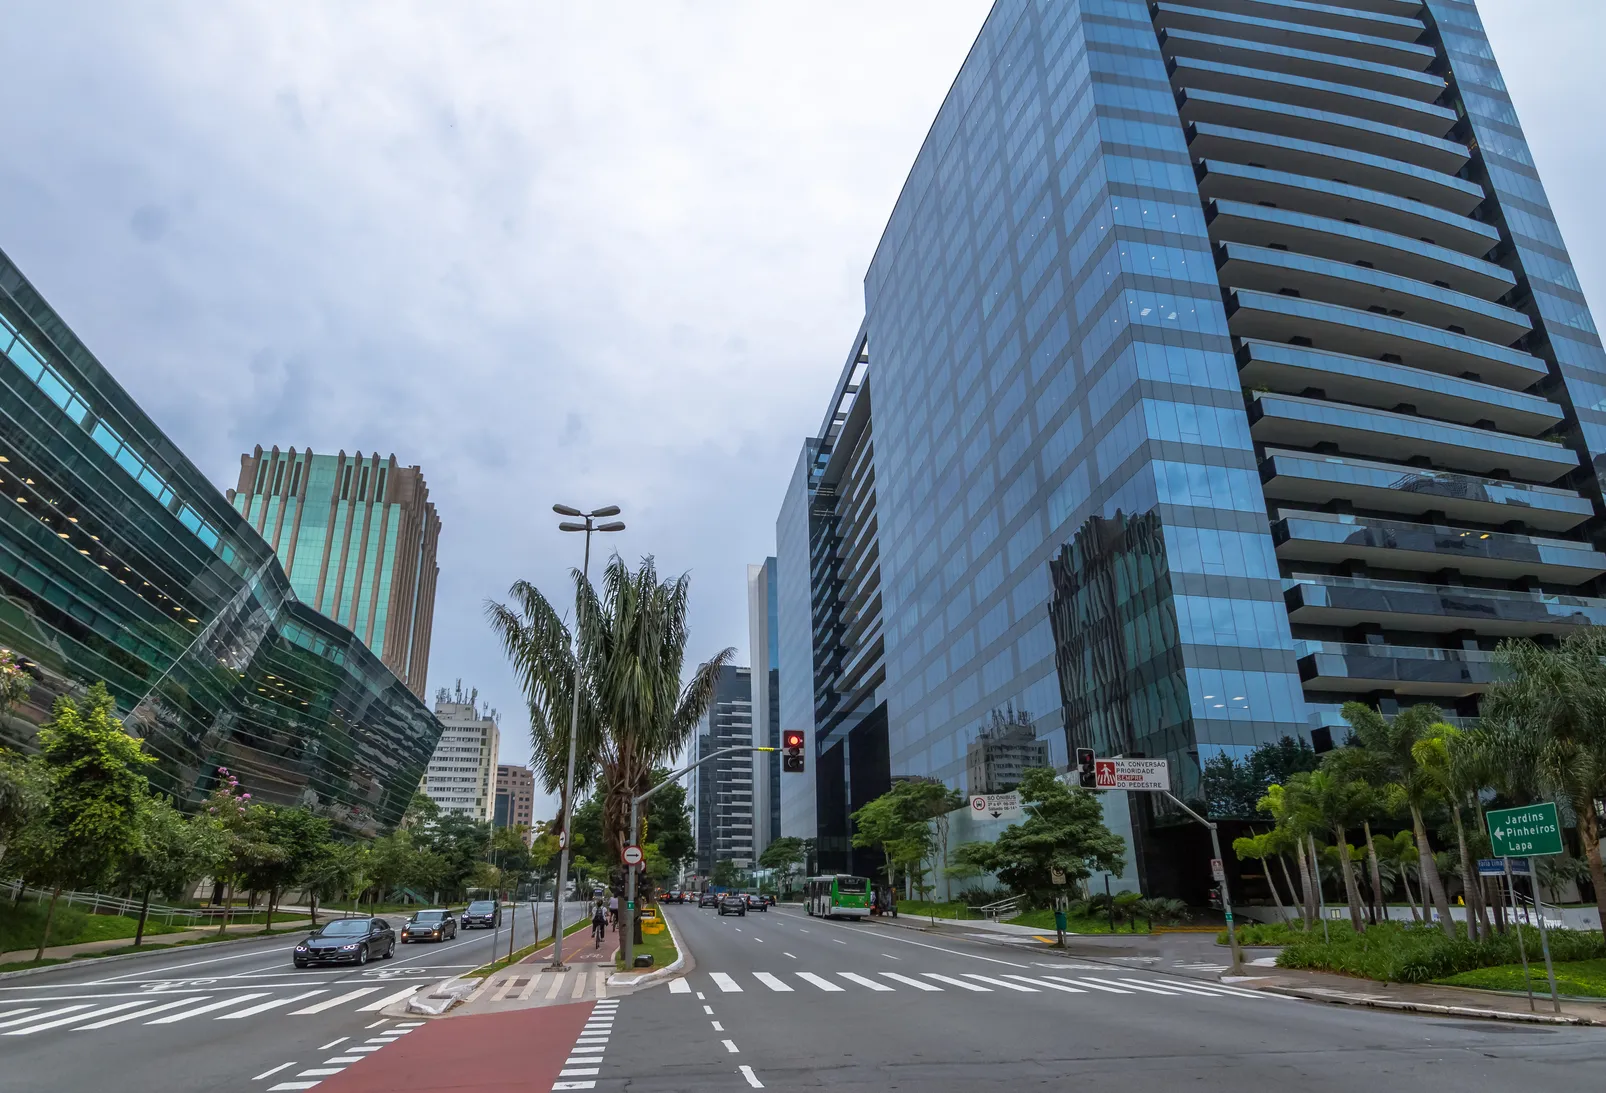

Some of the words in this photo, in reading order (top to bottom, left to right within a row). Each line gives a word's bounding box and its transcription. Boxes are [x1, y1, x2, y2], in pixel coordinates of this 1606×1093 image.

[1505, 813, 1544, 825] Jardins
[1506, 824, 1556, 837] Pinheiros
[1508, 841, 1533, 852] Lapa
